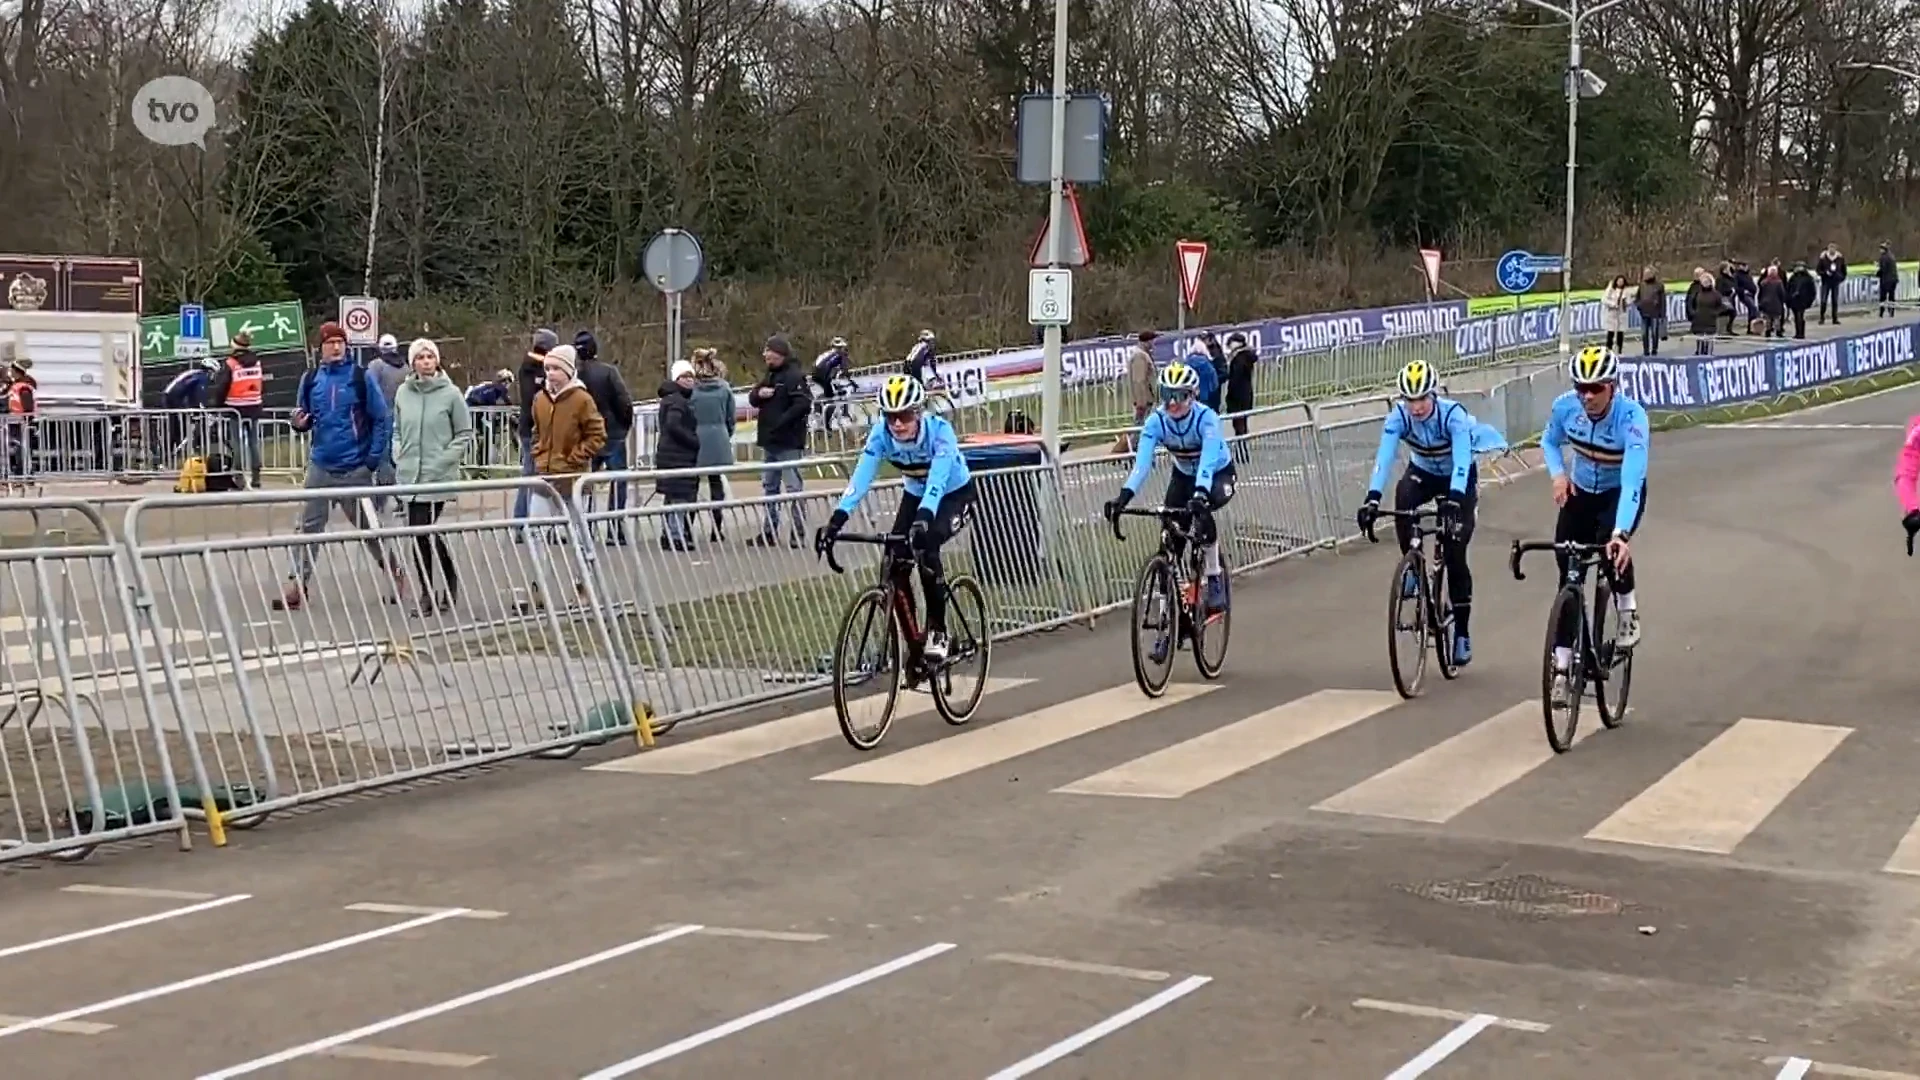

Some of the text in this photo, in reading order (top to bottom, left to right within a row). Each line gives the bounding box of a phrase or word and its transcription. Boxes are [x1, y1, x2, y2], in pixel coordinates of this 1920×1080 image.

[352, 315, 367, 326] 30
[1281, 317, 1363, 351] SHIMANO
[1784, 342, 1841, 388] BETCITY.NL
[1856, 327, 1914, 372] BETCITY.NL
[946, 367, 983, 399] UCI
[1617, 362, 1695, 405] ETCITY.NL
[1707, 353, 1769, 402] BETCITY.NL
